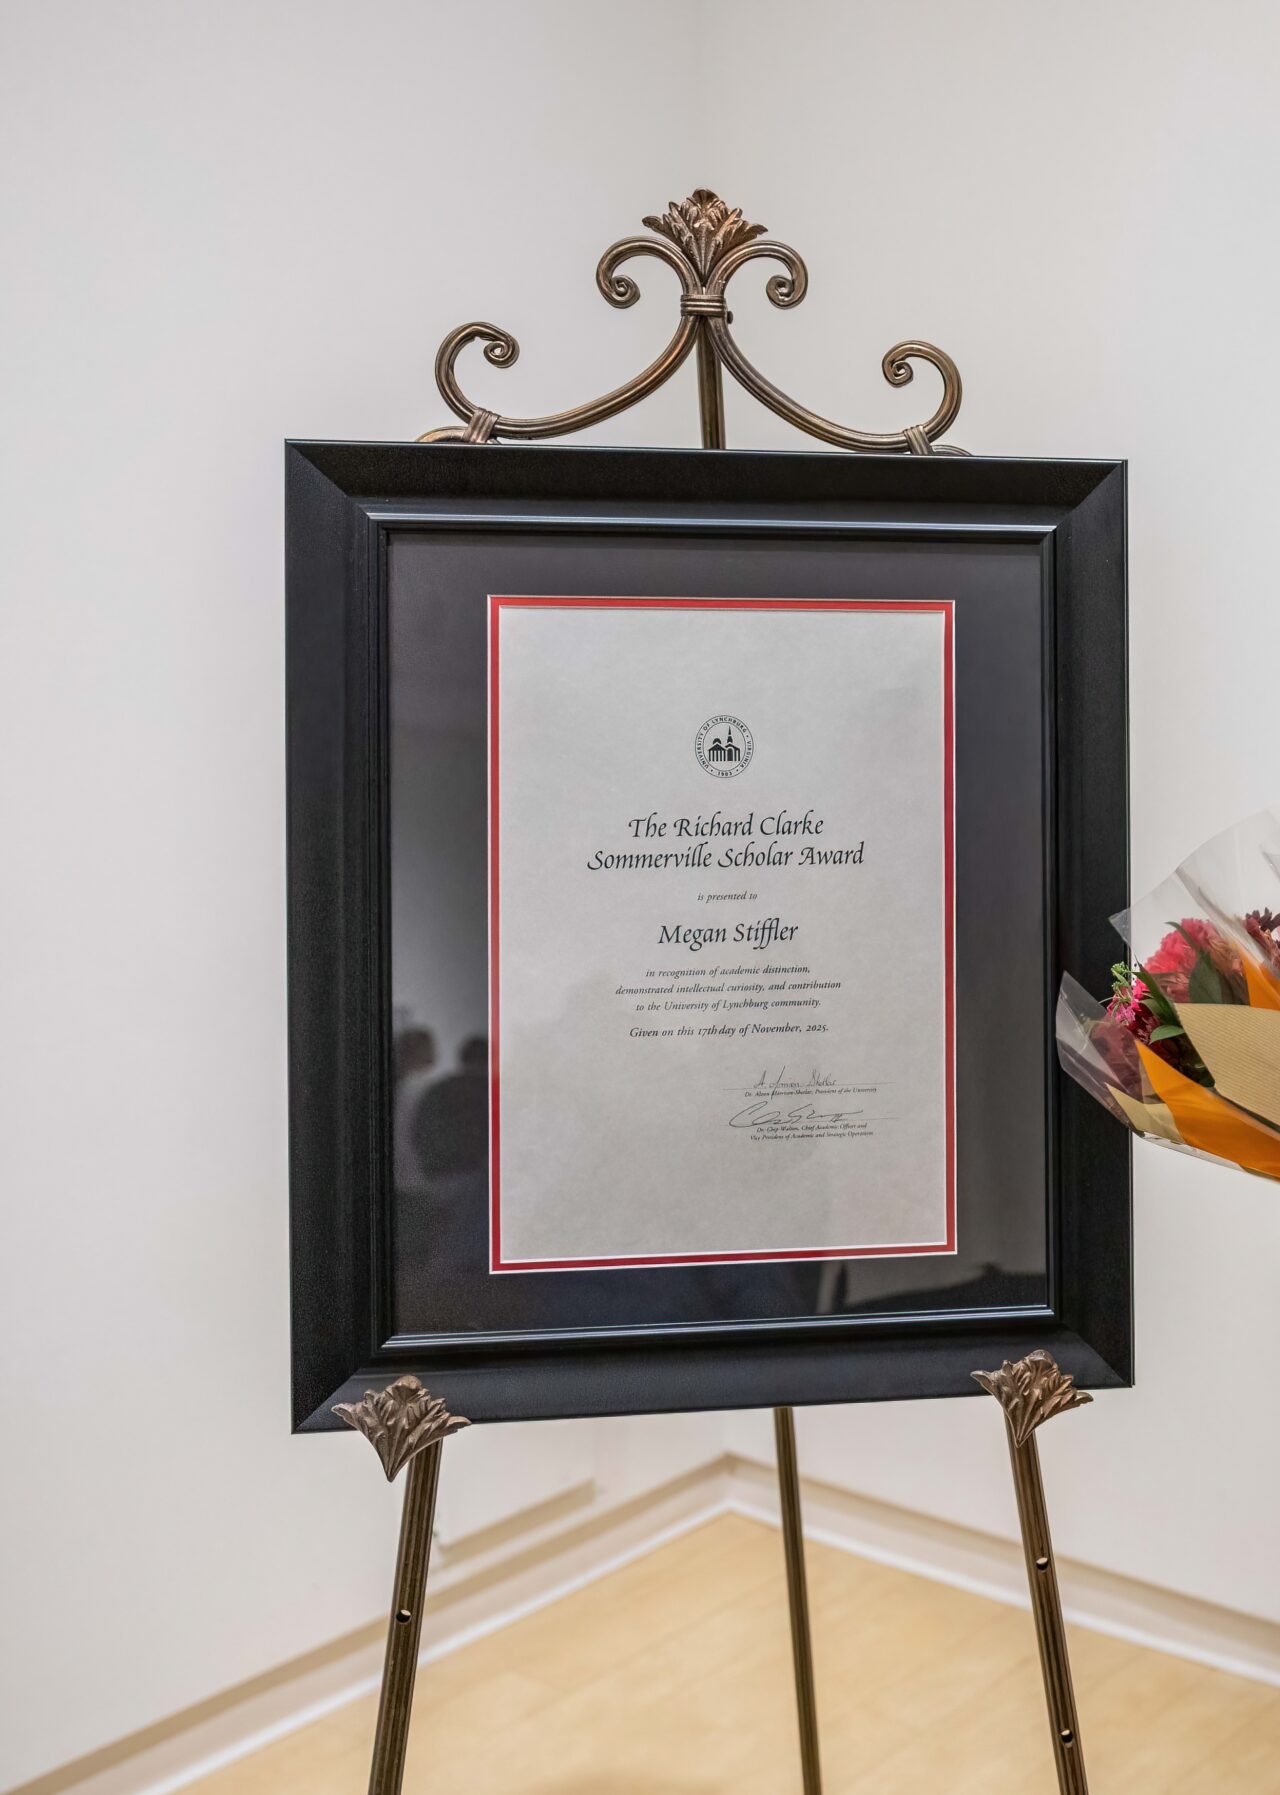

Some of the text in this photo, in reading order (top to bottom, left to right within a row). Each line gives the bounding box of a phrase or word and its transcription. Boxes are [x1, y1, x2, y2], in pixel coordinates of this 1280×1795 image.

[697, 717, 752, 769] UNIVERSITY OF LYNCHBURG VIRGINIA
[628, 809, 824, 838] The Richard Clarke
[587, 840, 865, 870] Sommerville Scholar Award
[697, 890, 758, 903] is presented to
[658, 917, 799, 951] Megan Stiffler
[645, 964, 811, 979] in recognition of academic distinction,
[615, 979, 841, 995] demonstrated intellectual curiosity, and contribution
[636, 998, 821, 1013] to the University of Lynchburg community.
[629, 1022, 829, 1038] Given on this 17th day of November, 2025.
